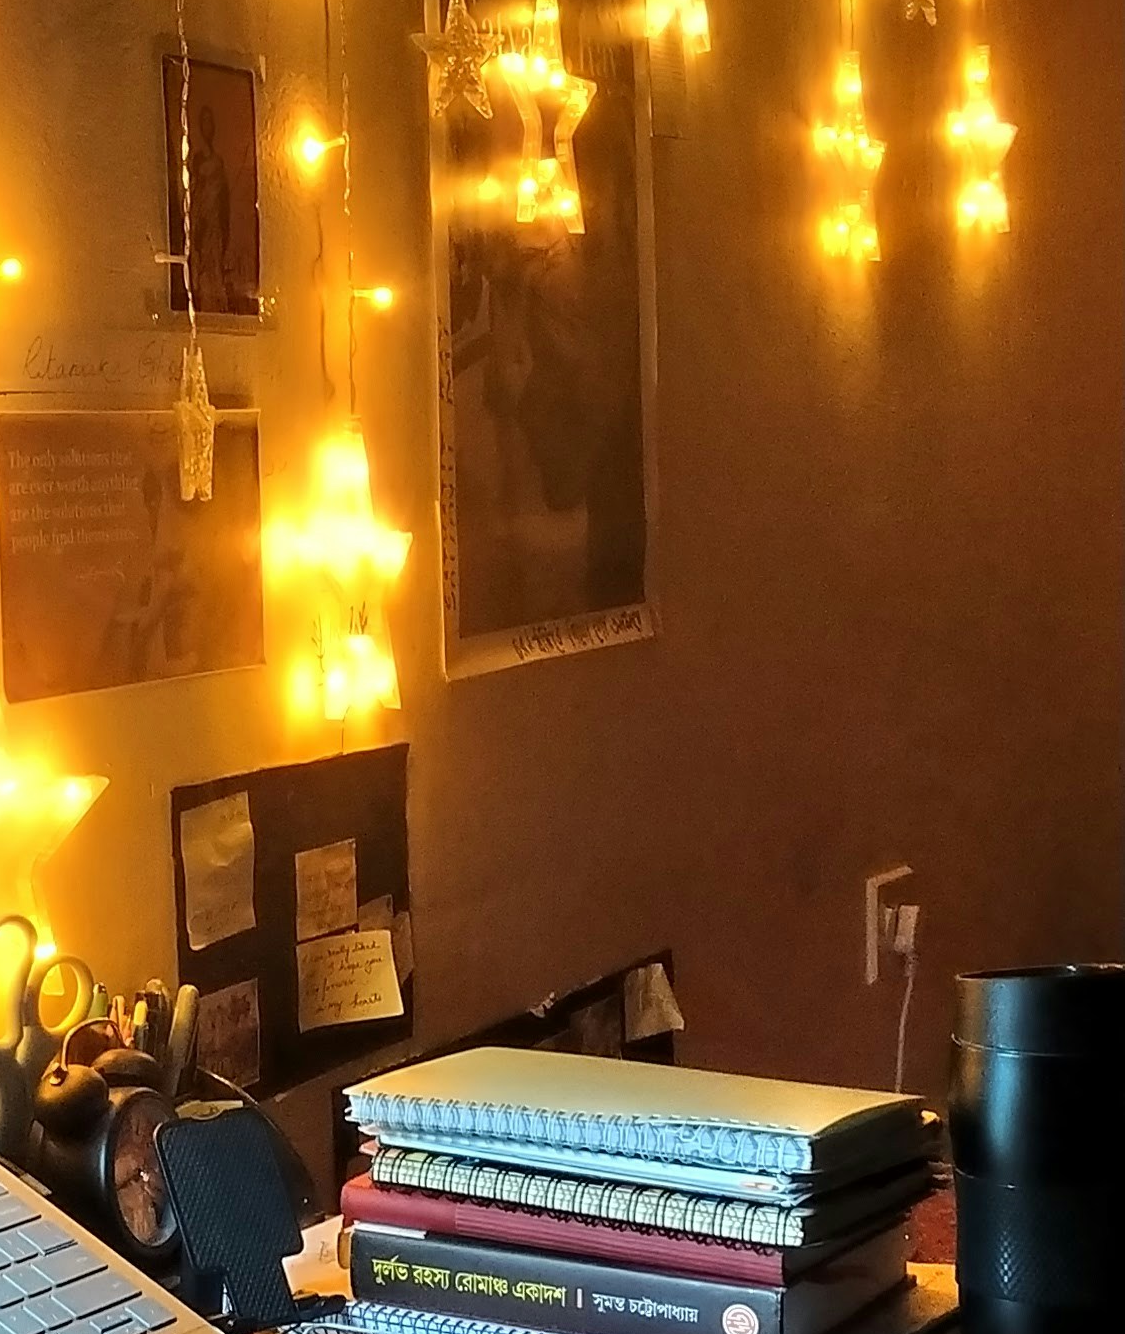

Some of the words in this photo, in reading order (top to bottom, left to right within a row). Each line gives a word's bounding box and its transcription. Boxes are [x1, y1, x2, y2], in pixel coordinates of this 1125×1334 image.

[371, 1255, 409, 1285] দুর্লভ
[411, 1264, 450, 1290] রহস্য
[454, 1271, 508, 1297] রোমাঞ্চ
[512, 1281, 567, 1308] একাদশ
